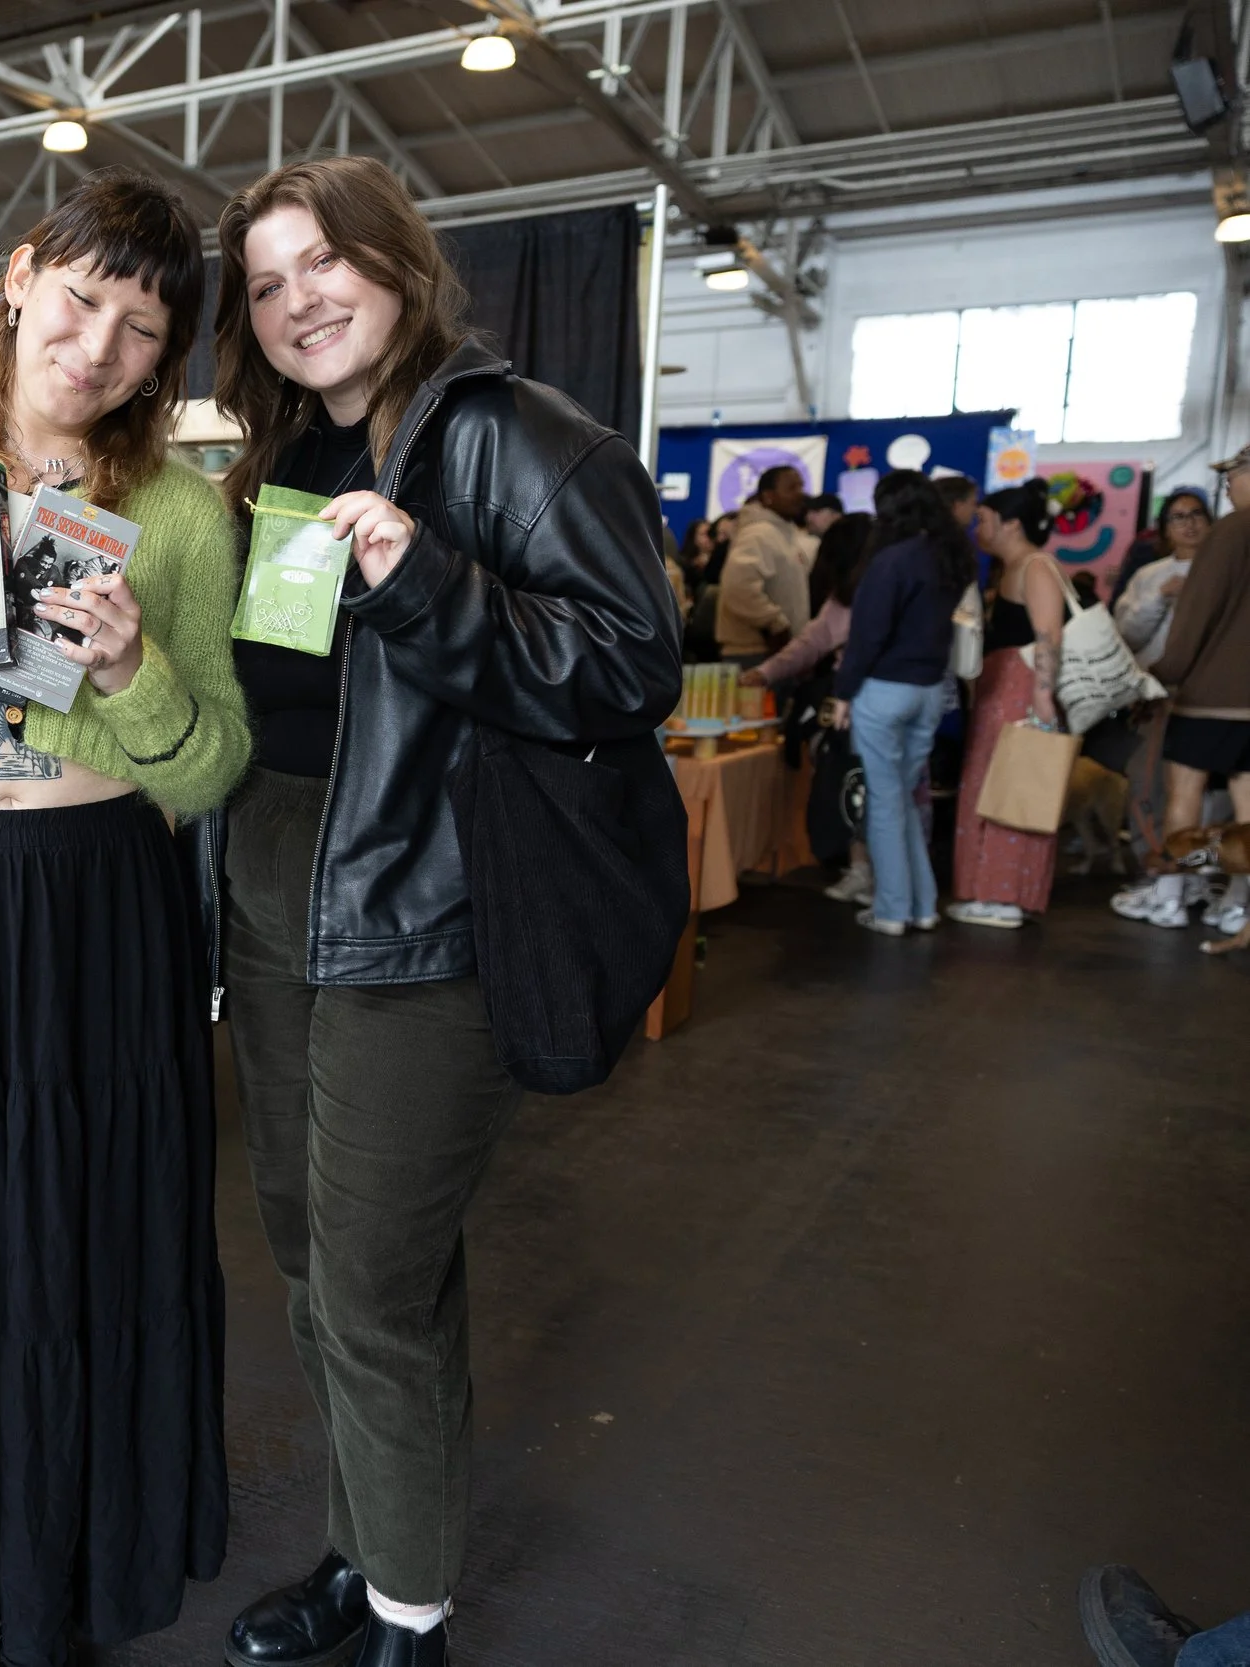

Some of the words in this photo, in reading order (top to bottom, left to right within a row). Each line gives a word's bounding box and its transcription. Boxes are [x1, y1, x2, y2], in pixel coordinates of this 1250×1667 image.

[35, 506, 59, 529] THE
[56, 516, 89, 542] SEVEN
[86, 529, 129, 560] SAMURAI
